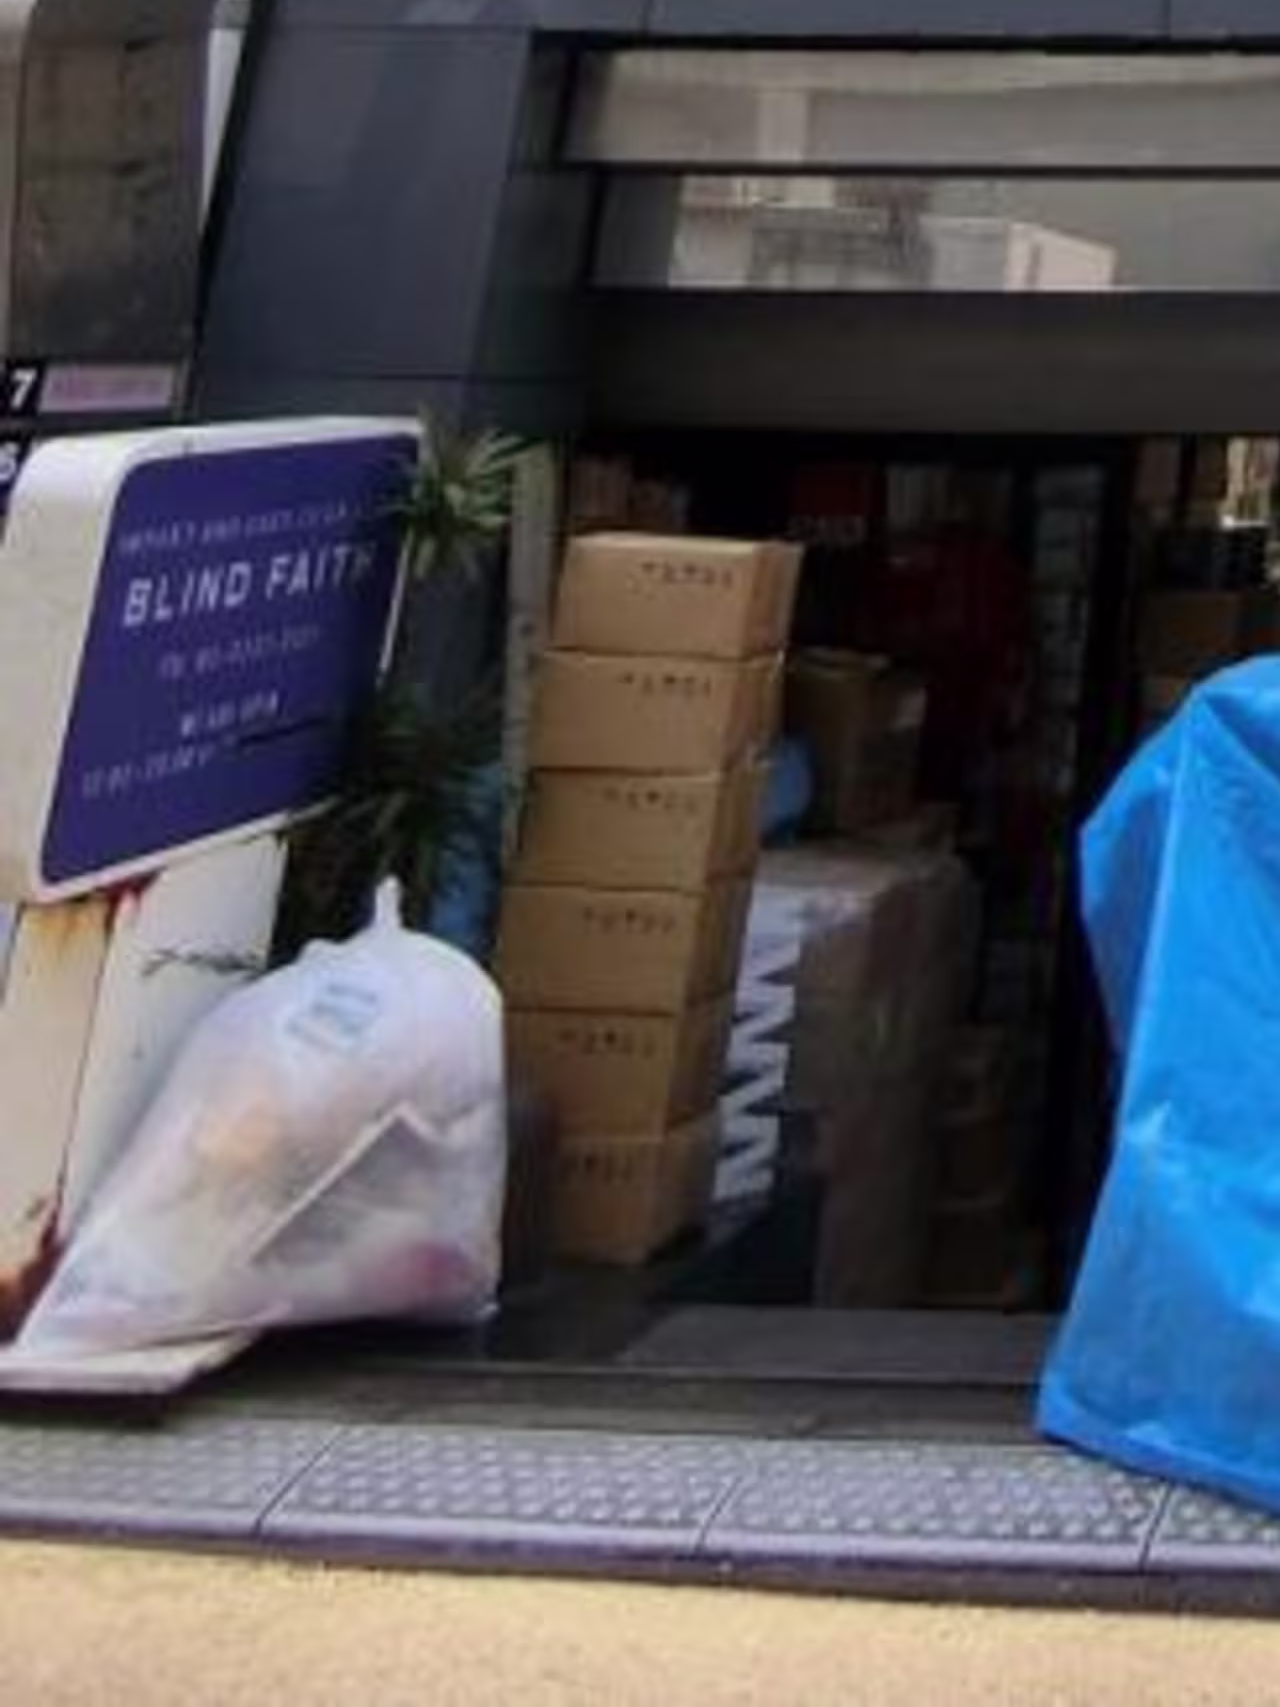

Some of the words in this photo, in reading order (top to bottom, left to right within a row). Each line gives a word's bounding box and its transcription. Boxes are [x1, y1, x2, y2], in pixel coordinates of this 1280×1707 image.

[11, 368, 38, 411] 7
[124, 561, 251, 626] BLIND
[265, 541, 376, 600] FAITH
